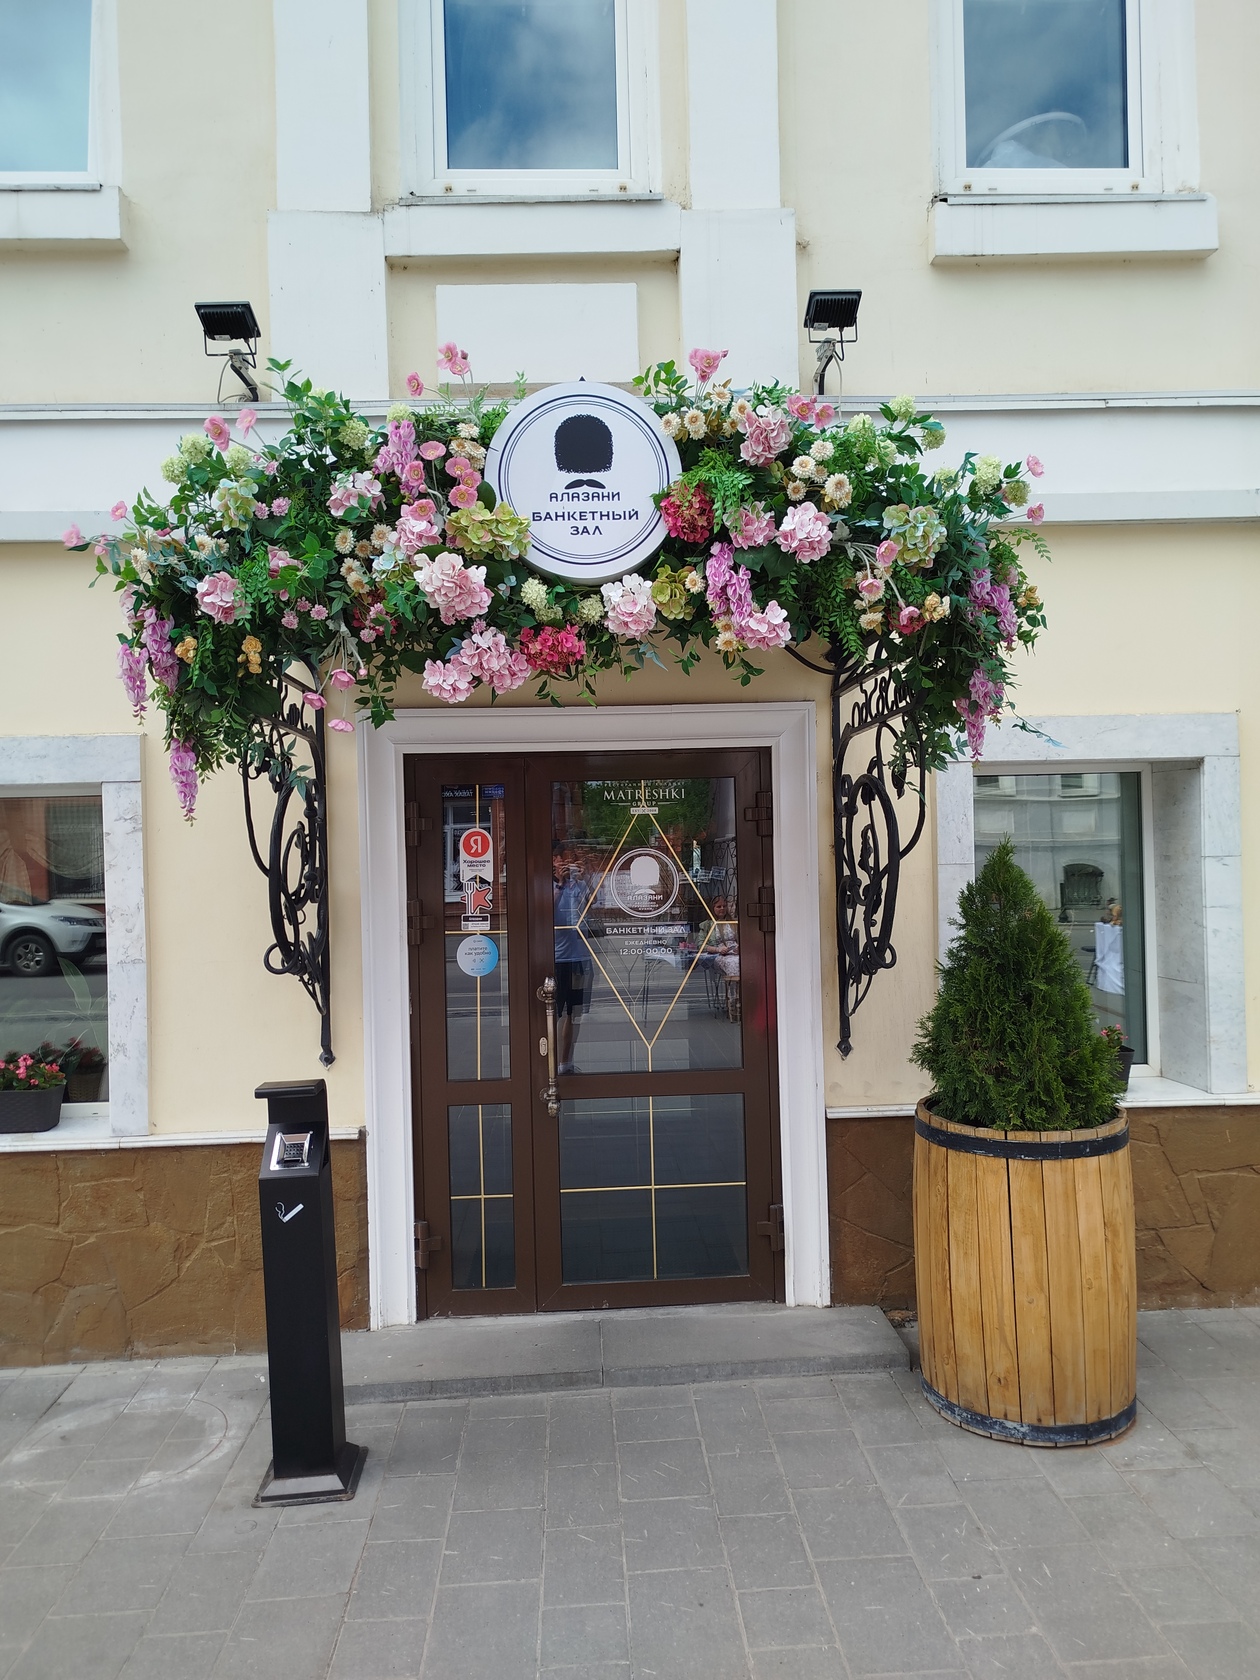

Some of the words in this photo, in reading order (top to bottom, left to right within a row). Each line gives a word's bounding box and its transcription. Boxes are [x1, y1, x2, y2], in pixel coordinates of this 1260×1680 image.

[549, 491, 621, 503] АЛАЗАНИ
[531, 508, 639, 522] БАНКЕТНЫЙ
[570, 525, 603, 536] ЗАЛ
[470, 835, 482, 854] Я
[606, 926, 665, 935] БАНКЕТНЫЙ
[667, 925, 686, 934] ЗАЛ
[620, 947, 673, 956] 12:00-0000
